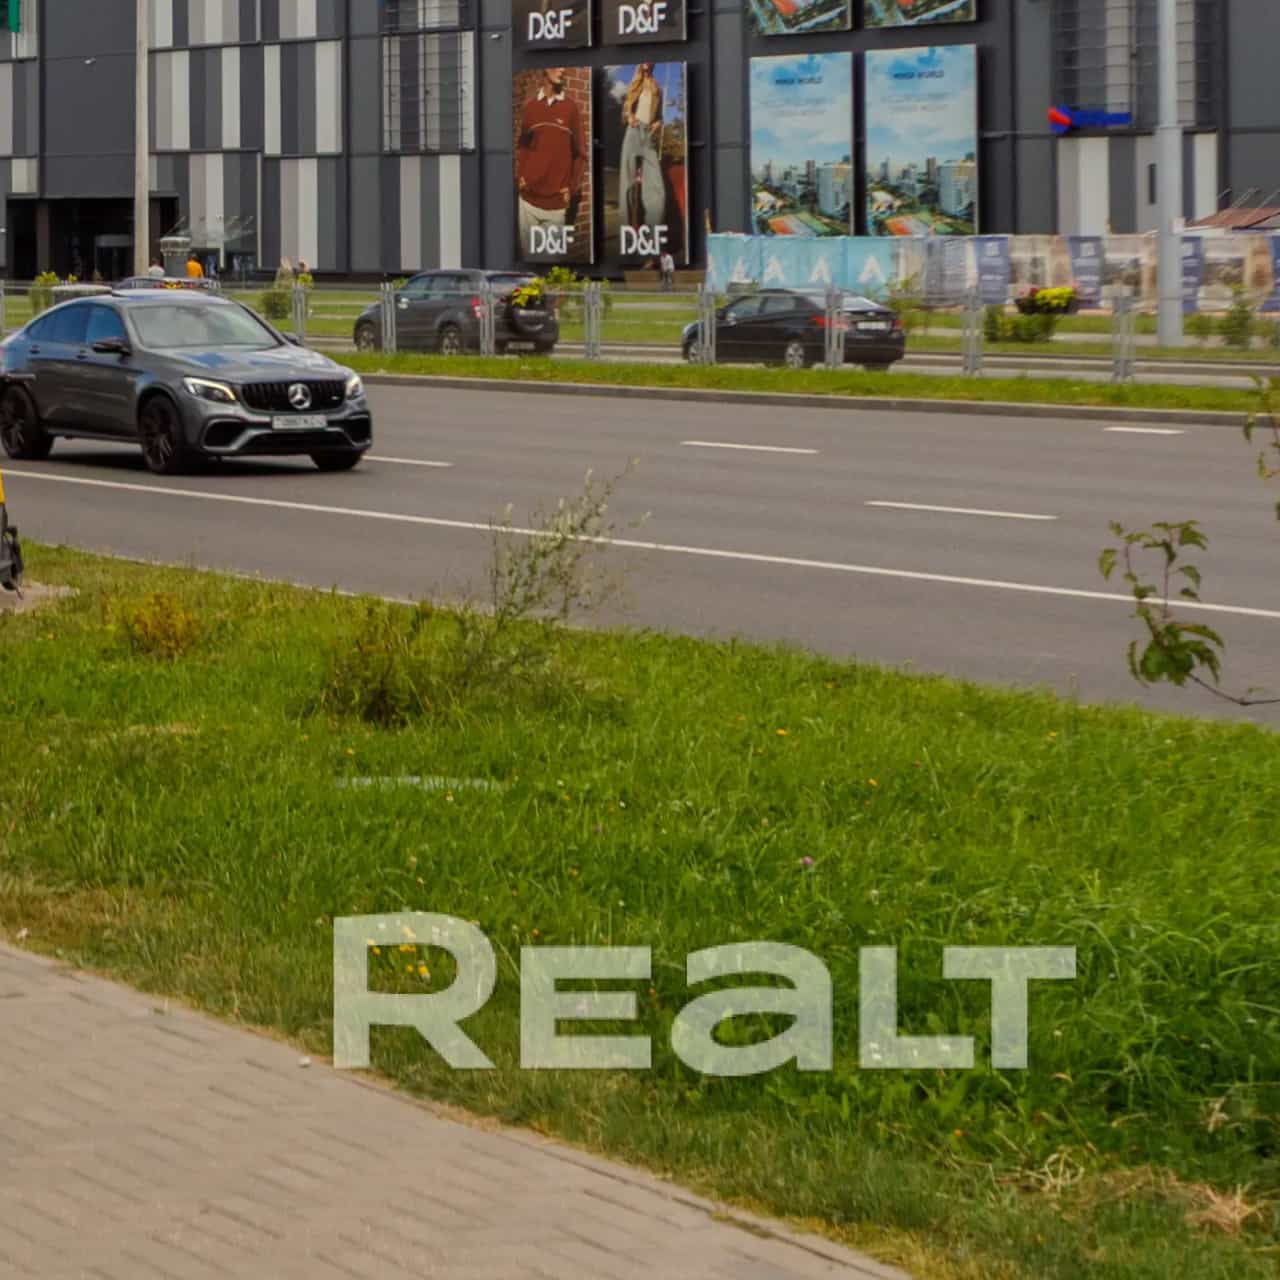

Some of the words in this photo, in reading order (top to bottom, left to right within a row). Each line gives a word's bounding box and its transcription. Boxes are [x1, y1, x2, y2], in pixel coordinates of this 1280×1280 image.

[528, 9, 574, 40] D&F
[617, 2, 668, 35] D&F
[530, 224, 575, 255] D&F
[619, 224, 669, 256] D&F
